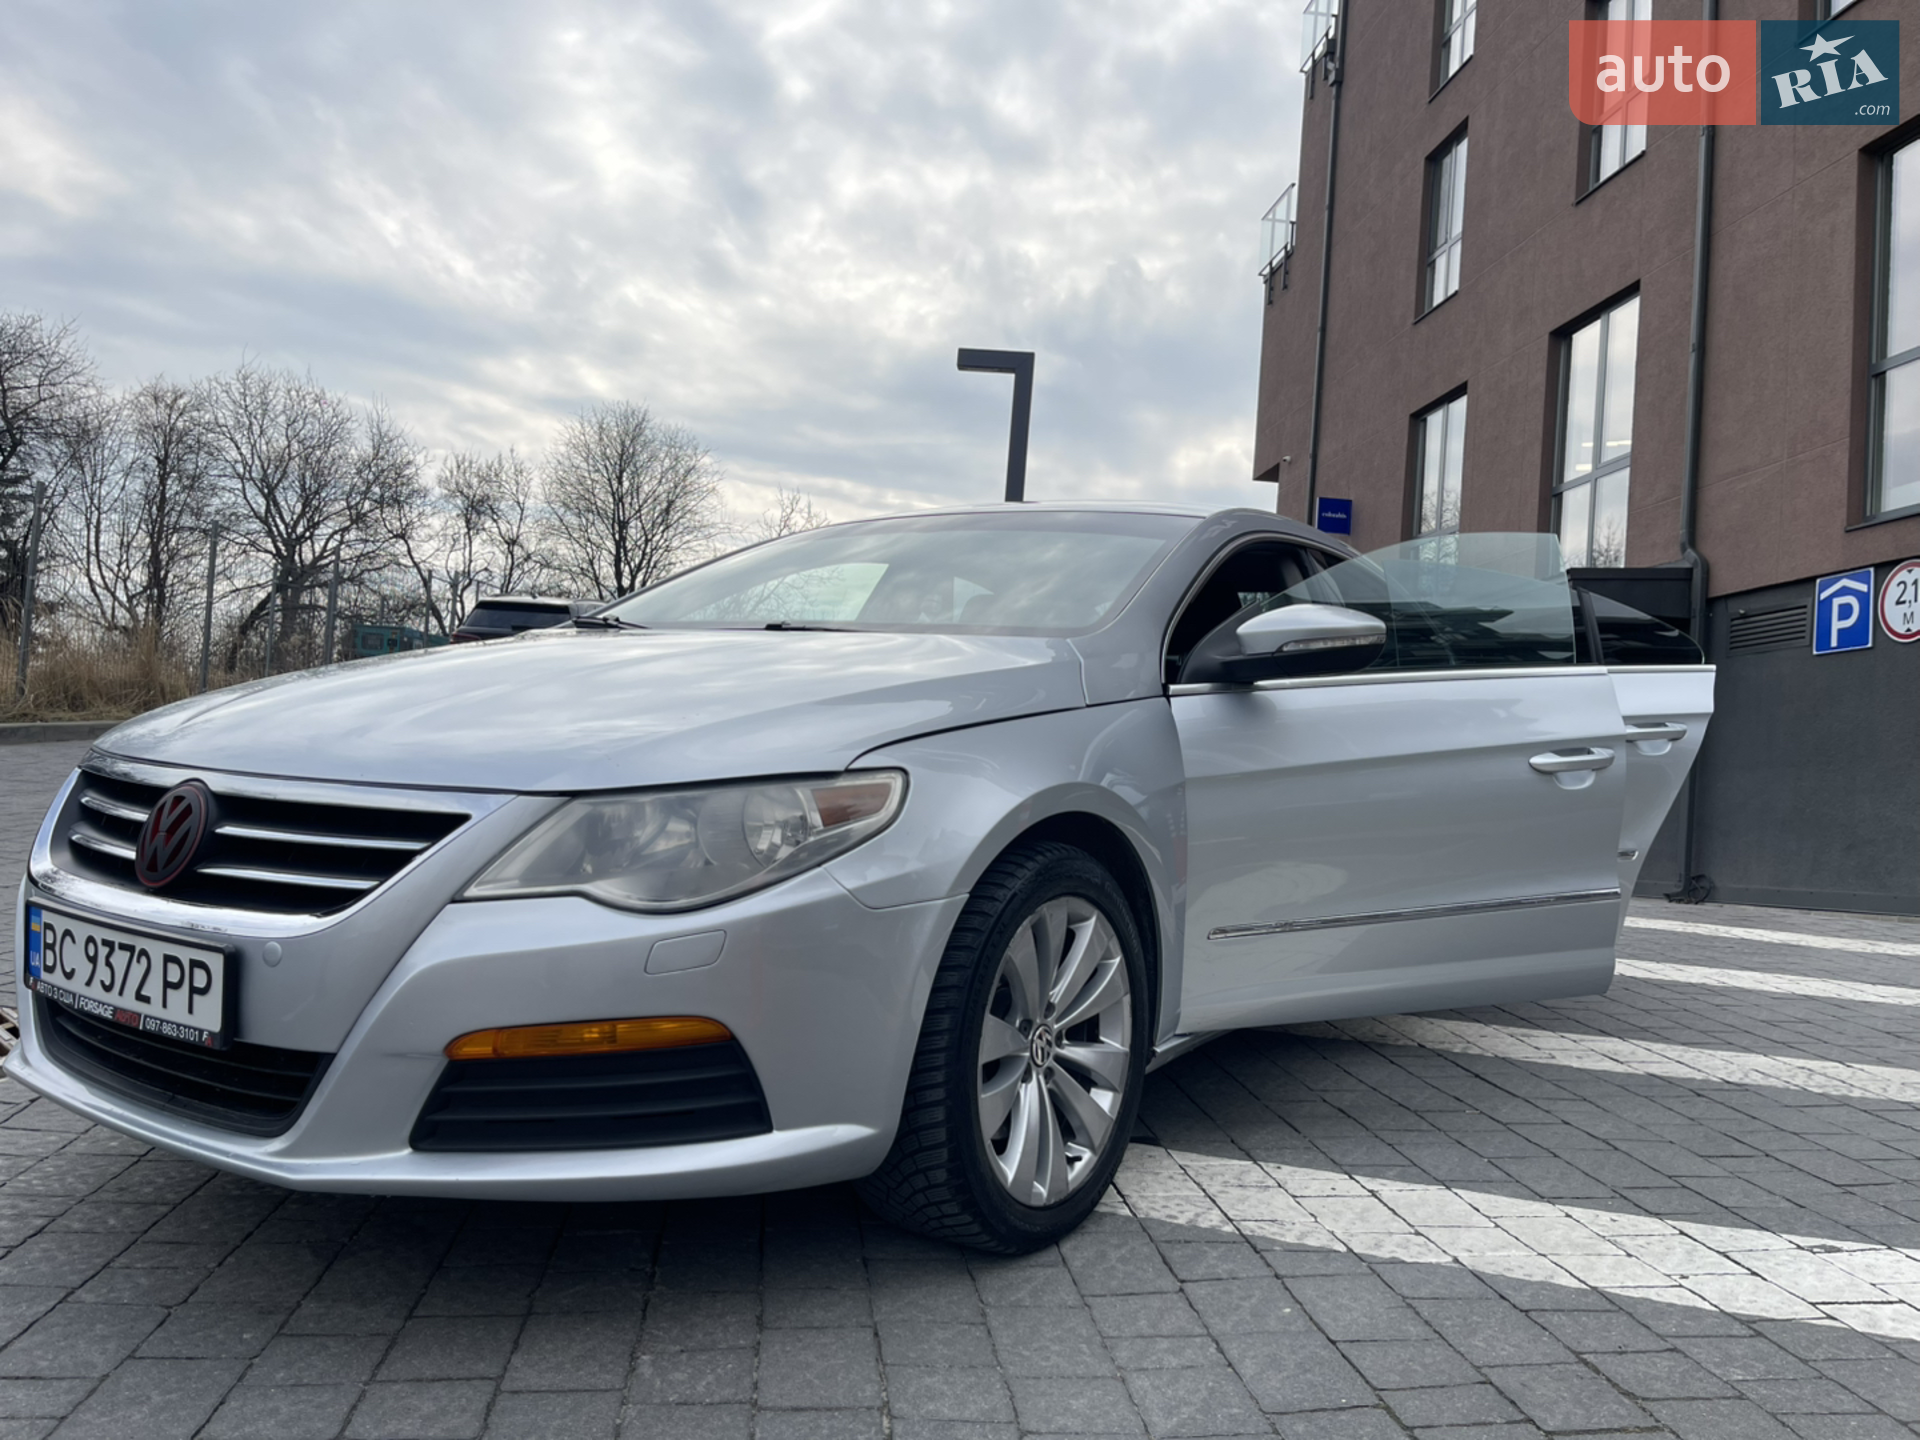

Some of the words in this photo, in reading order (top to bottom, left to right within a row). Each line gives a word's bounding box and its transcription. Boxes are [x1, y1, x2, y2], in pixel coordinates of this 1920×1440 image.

[1830, 595, 1860, 648] P
[30, 950, 41, 968] UA
[42, 921, 77, 981] BC
[84, 934, 152, 1005] 9372
[162, 953, 213, 1015] PP
[80, 996, 114, 1019] FORSAGE
[145, 1017, 199, 1042] 097-863-3101
